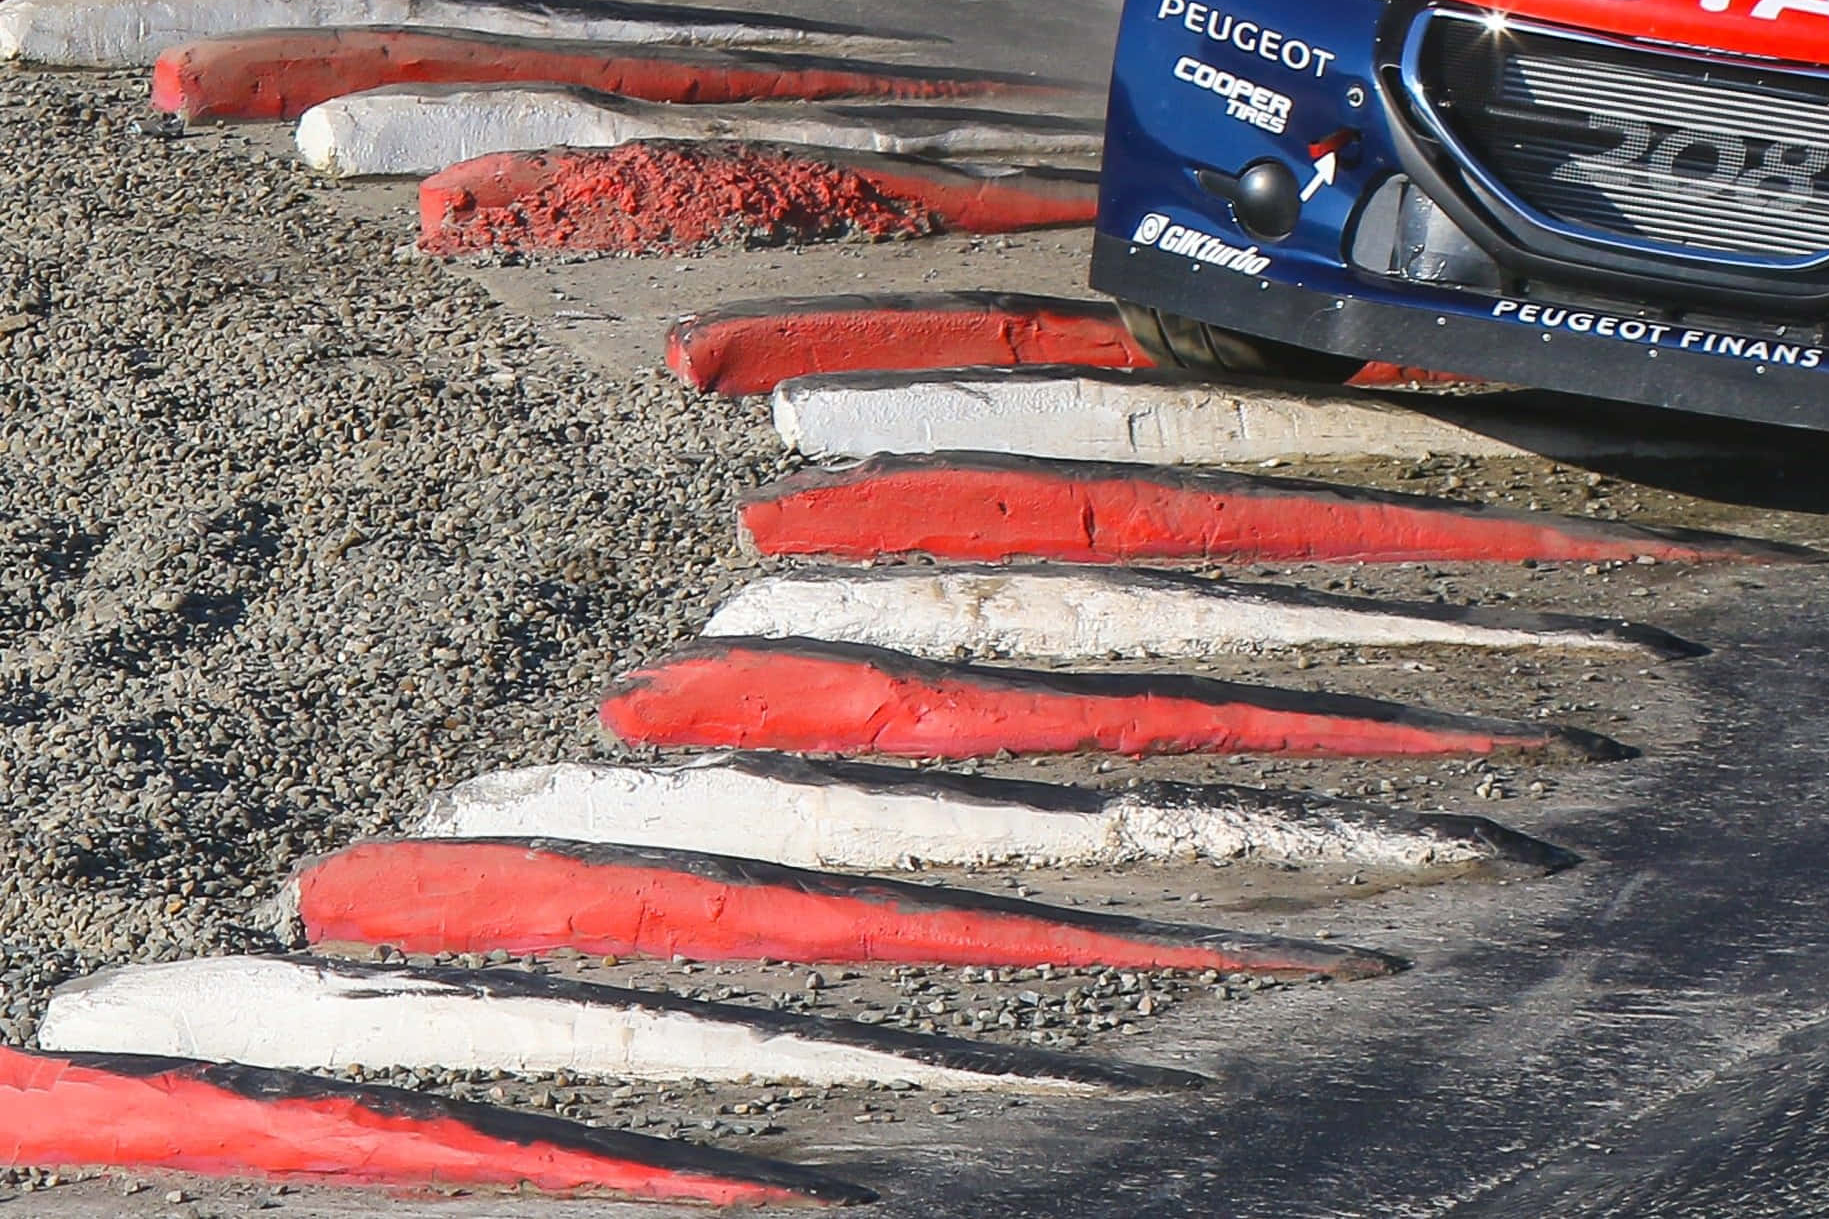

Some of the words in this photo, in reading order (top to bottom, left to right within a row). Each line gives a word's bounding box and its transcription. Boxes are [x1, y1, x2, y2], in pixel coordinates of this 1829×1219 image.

[1174, 57, 1293, 118] COOPER
[1224, 97, 1287, 135] TIRES
[1492, 300, 1671, 345] PEUGEOT
[1680, 331, 1824, 368] FINANS
